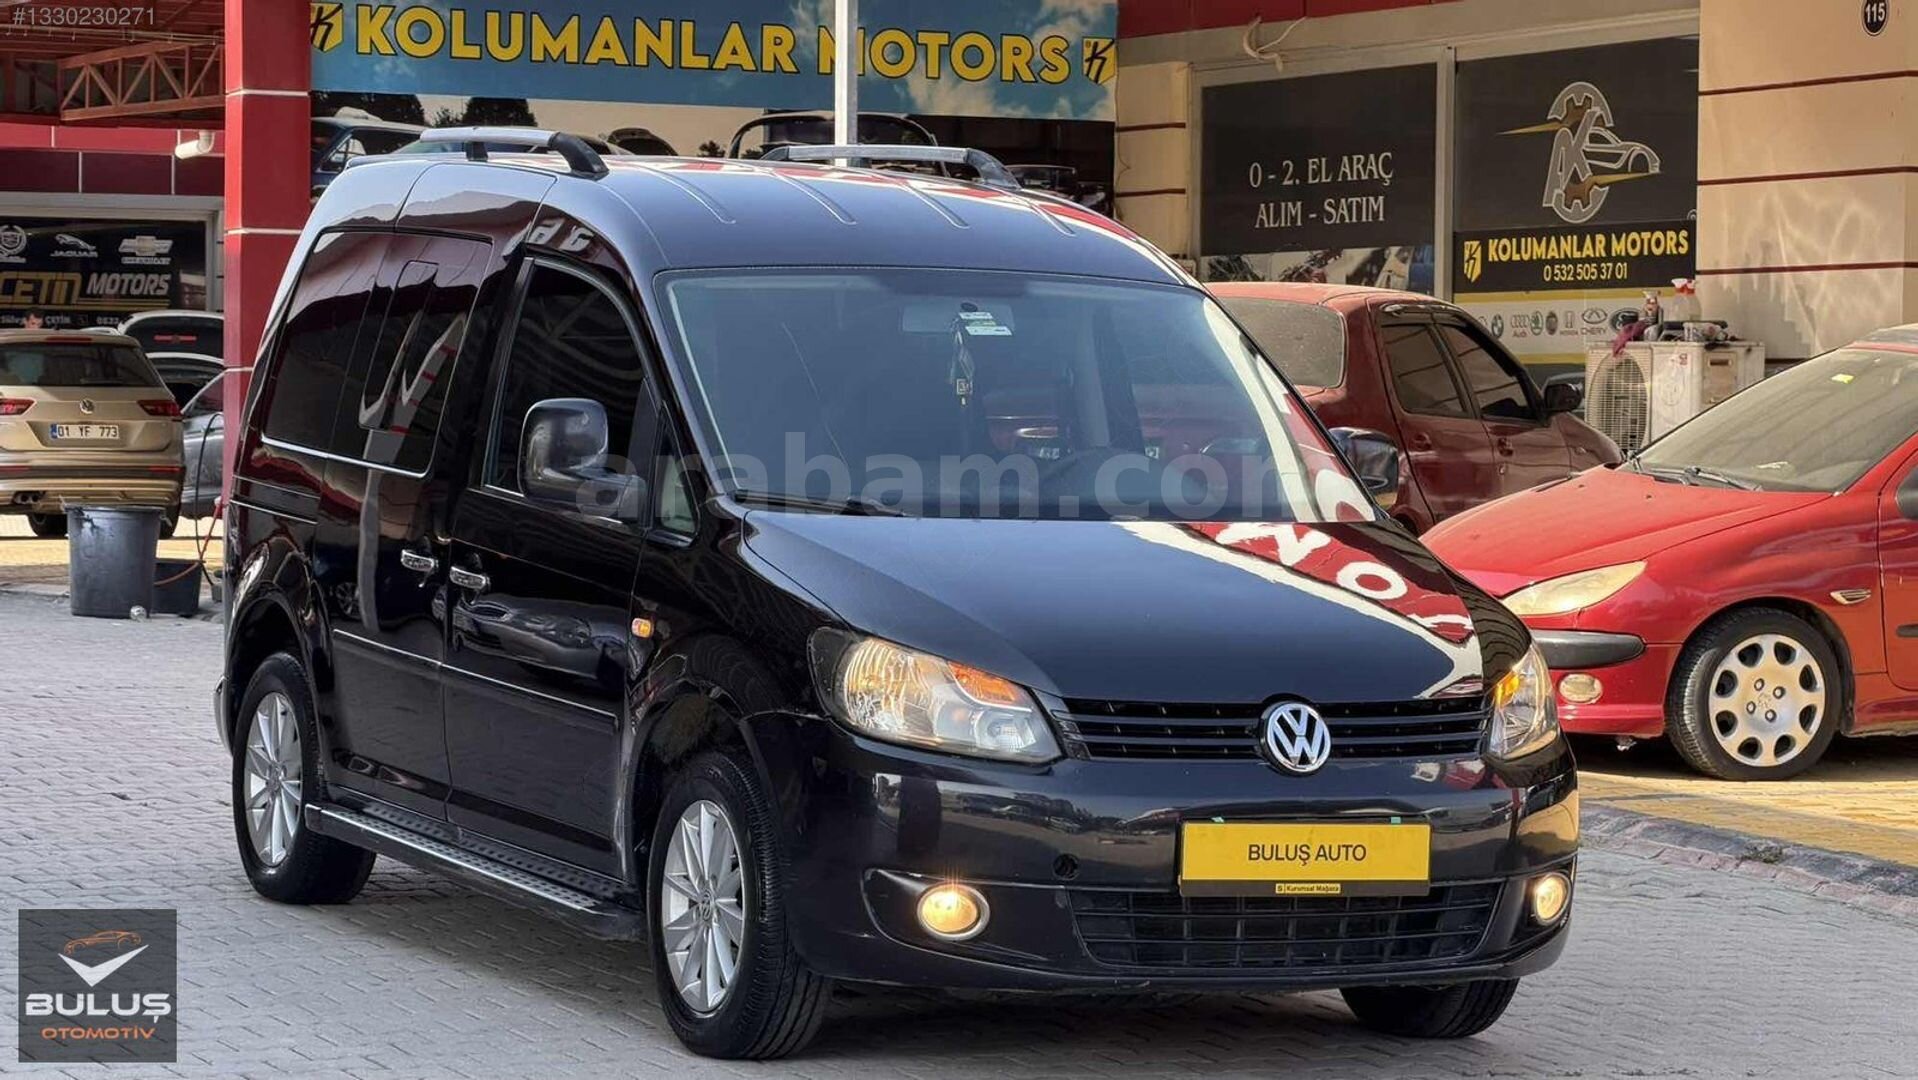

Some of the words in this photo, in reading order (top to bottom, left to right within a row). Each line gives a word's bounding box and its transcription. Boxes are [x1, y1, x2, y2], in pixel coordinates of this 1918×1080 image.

[1865, 3, 1885, 22] 115
[356, 4, 799, 74] KOLUMANLAR
[1250, 162, 1262, 188] 0
[1282, 160, 1300, 185] 2.
[1307, 157, 1332, 184] EL
[1338, 152, 1393, 186] ARAÇ
[1255, 201, 1302, 228] ALIM
[1323, 195, 1385, 224] SATIM
[1488, 233, 1606, 262] KOLUMANLAR
[1611, 229, 1689, 258] MOTORS
[1543, 265, 1552, 282] 0
[1553, 264, 1574, 281] 532
[1576, 263, 1597, 280] 505
[1599, 263, 1612, 279] 37
[1615, 262, 1628, 279] 01
[87, 273, 171, 295] MOTORS
[58, 424, 70, 436] 01
[79, 425, 91, 437] YF
[99, 425, 118, 437] 773
[1248, 844, 1310, 866] BULUŞ
[1315, 844, 1367, 861] AUTO
